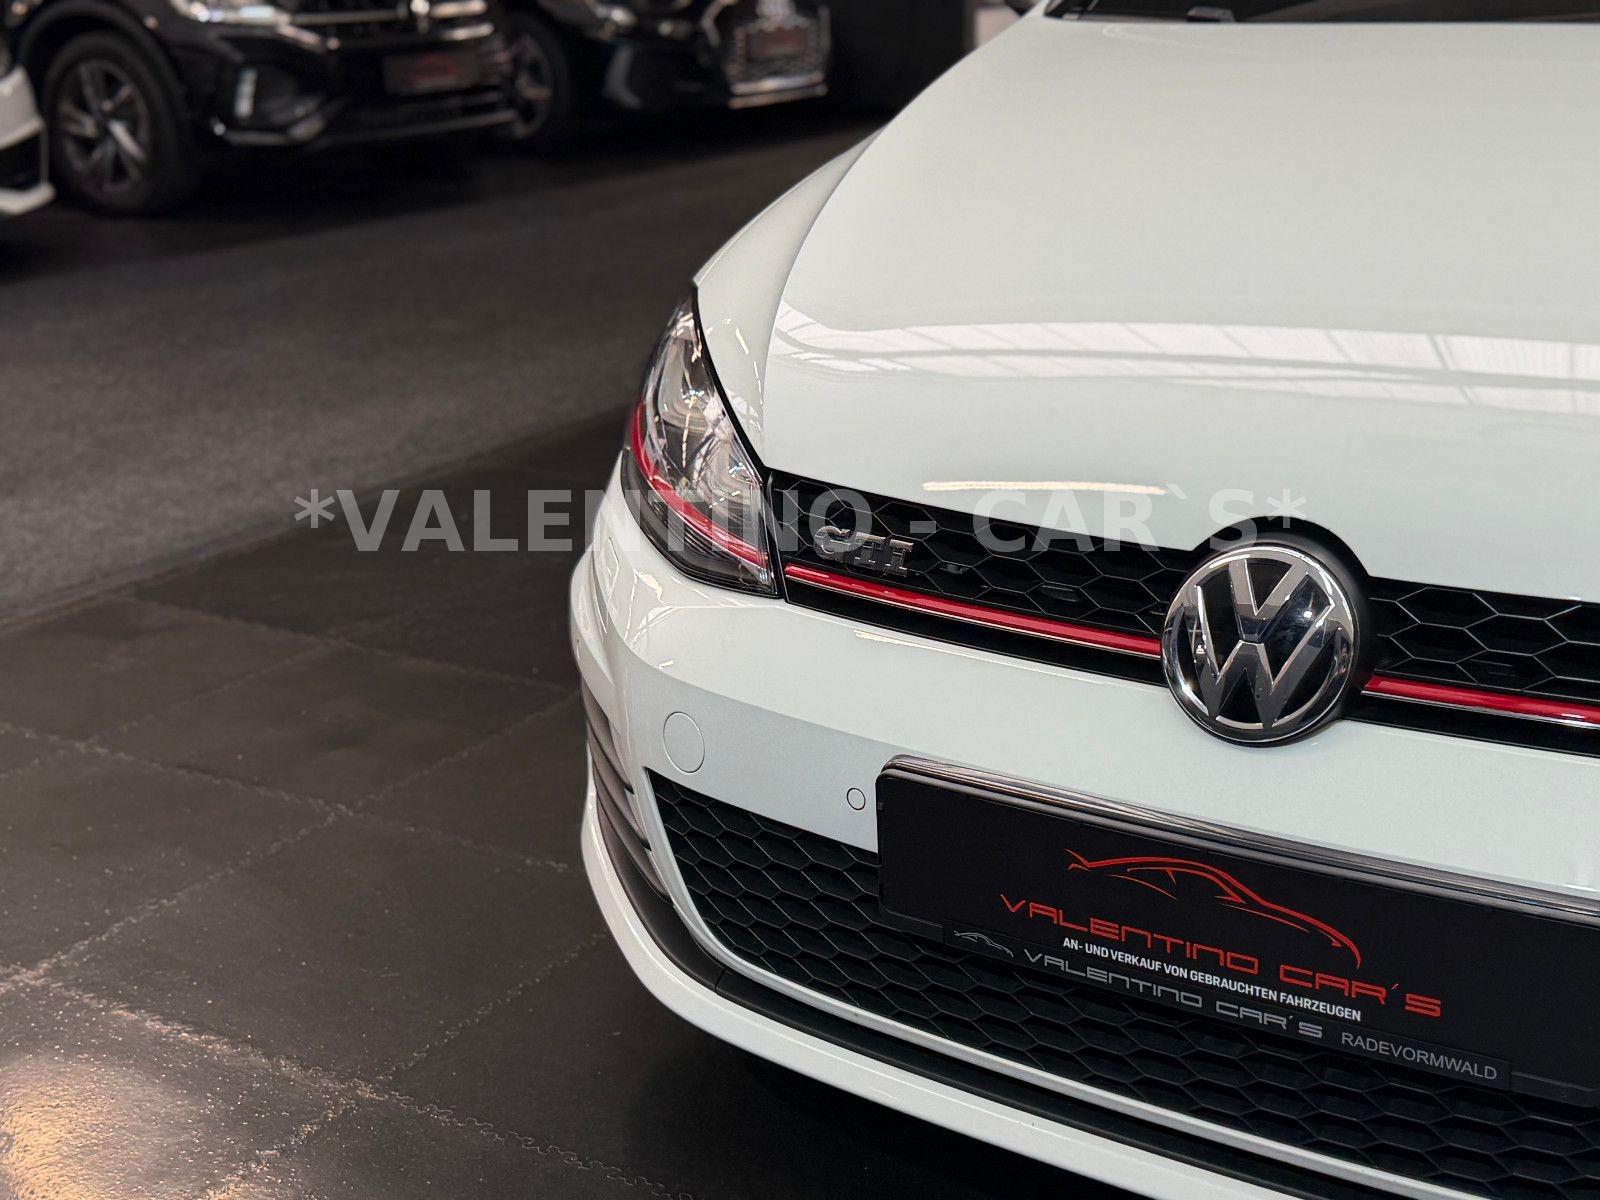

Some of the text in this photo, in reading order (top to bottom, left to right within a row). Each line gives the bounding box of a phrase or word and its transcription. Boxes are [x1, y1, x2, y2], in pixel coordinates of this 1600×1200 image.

[813, 525, 914, 577] GTI
[1000, 894, 1259, 975] VALENTINO
[1024, 948, 1202, 1008] VALENTINO
[1341, 1031, 1498, 1080] RADEVORMWALD
[1062, 936, 1362, 1022] AN- UND VERKAUF VON GEBRAUCHTEN FAHRZEUGEN
